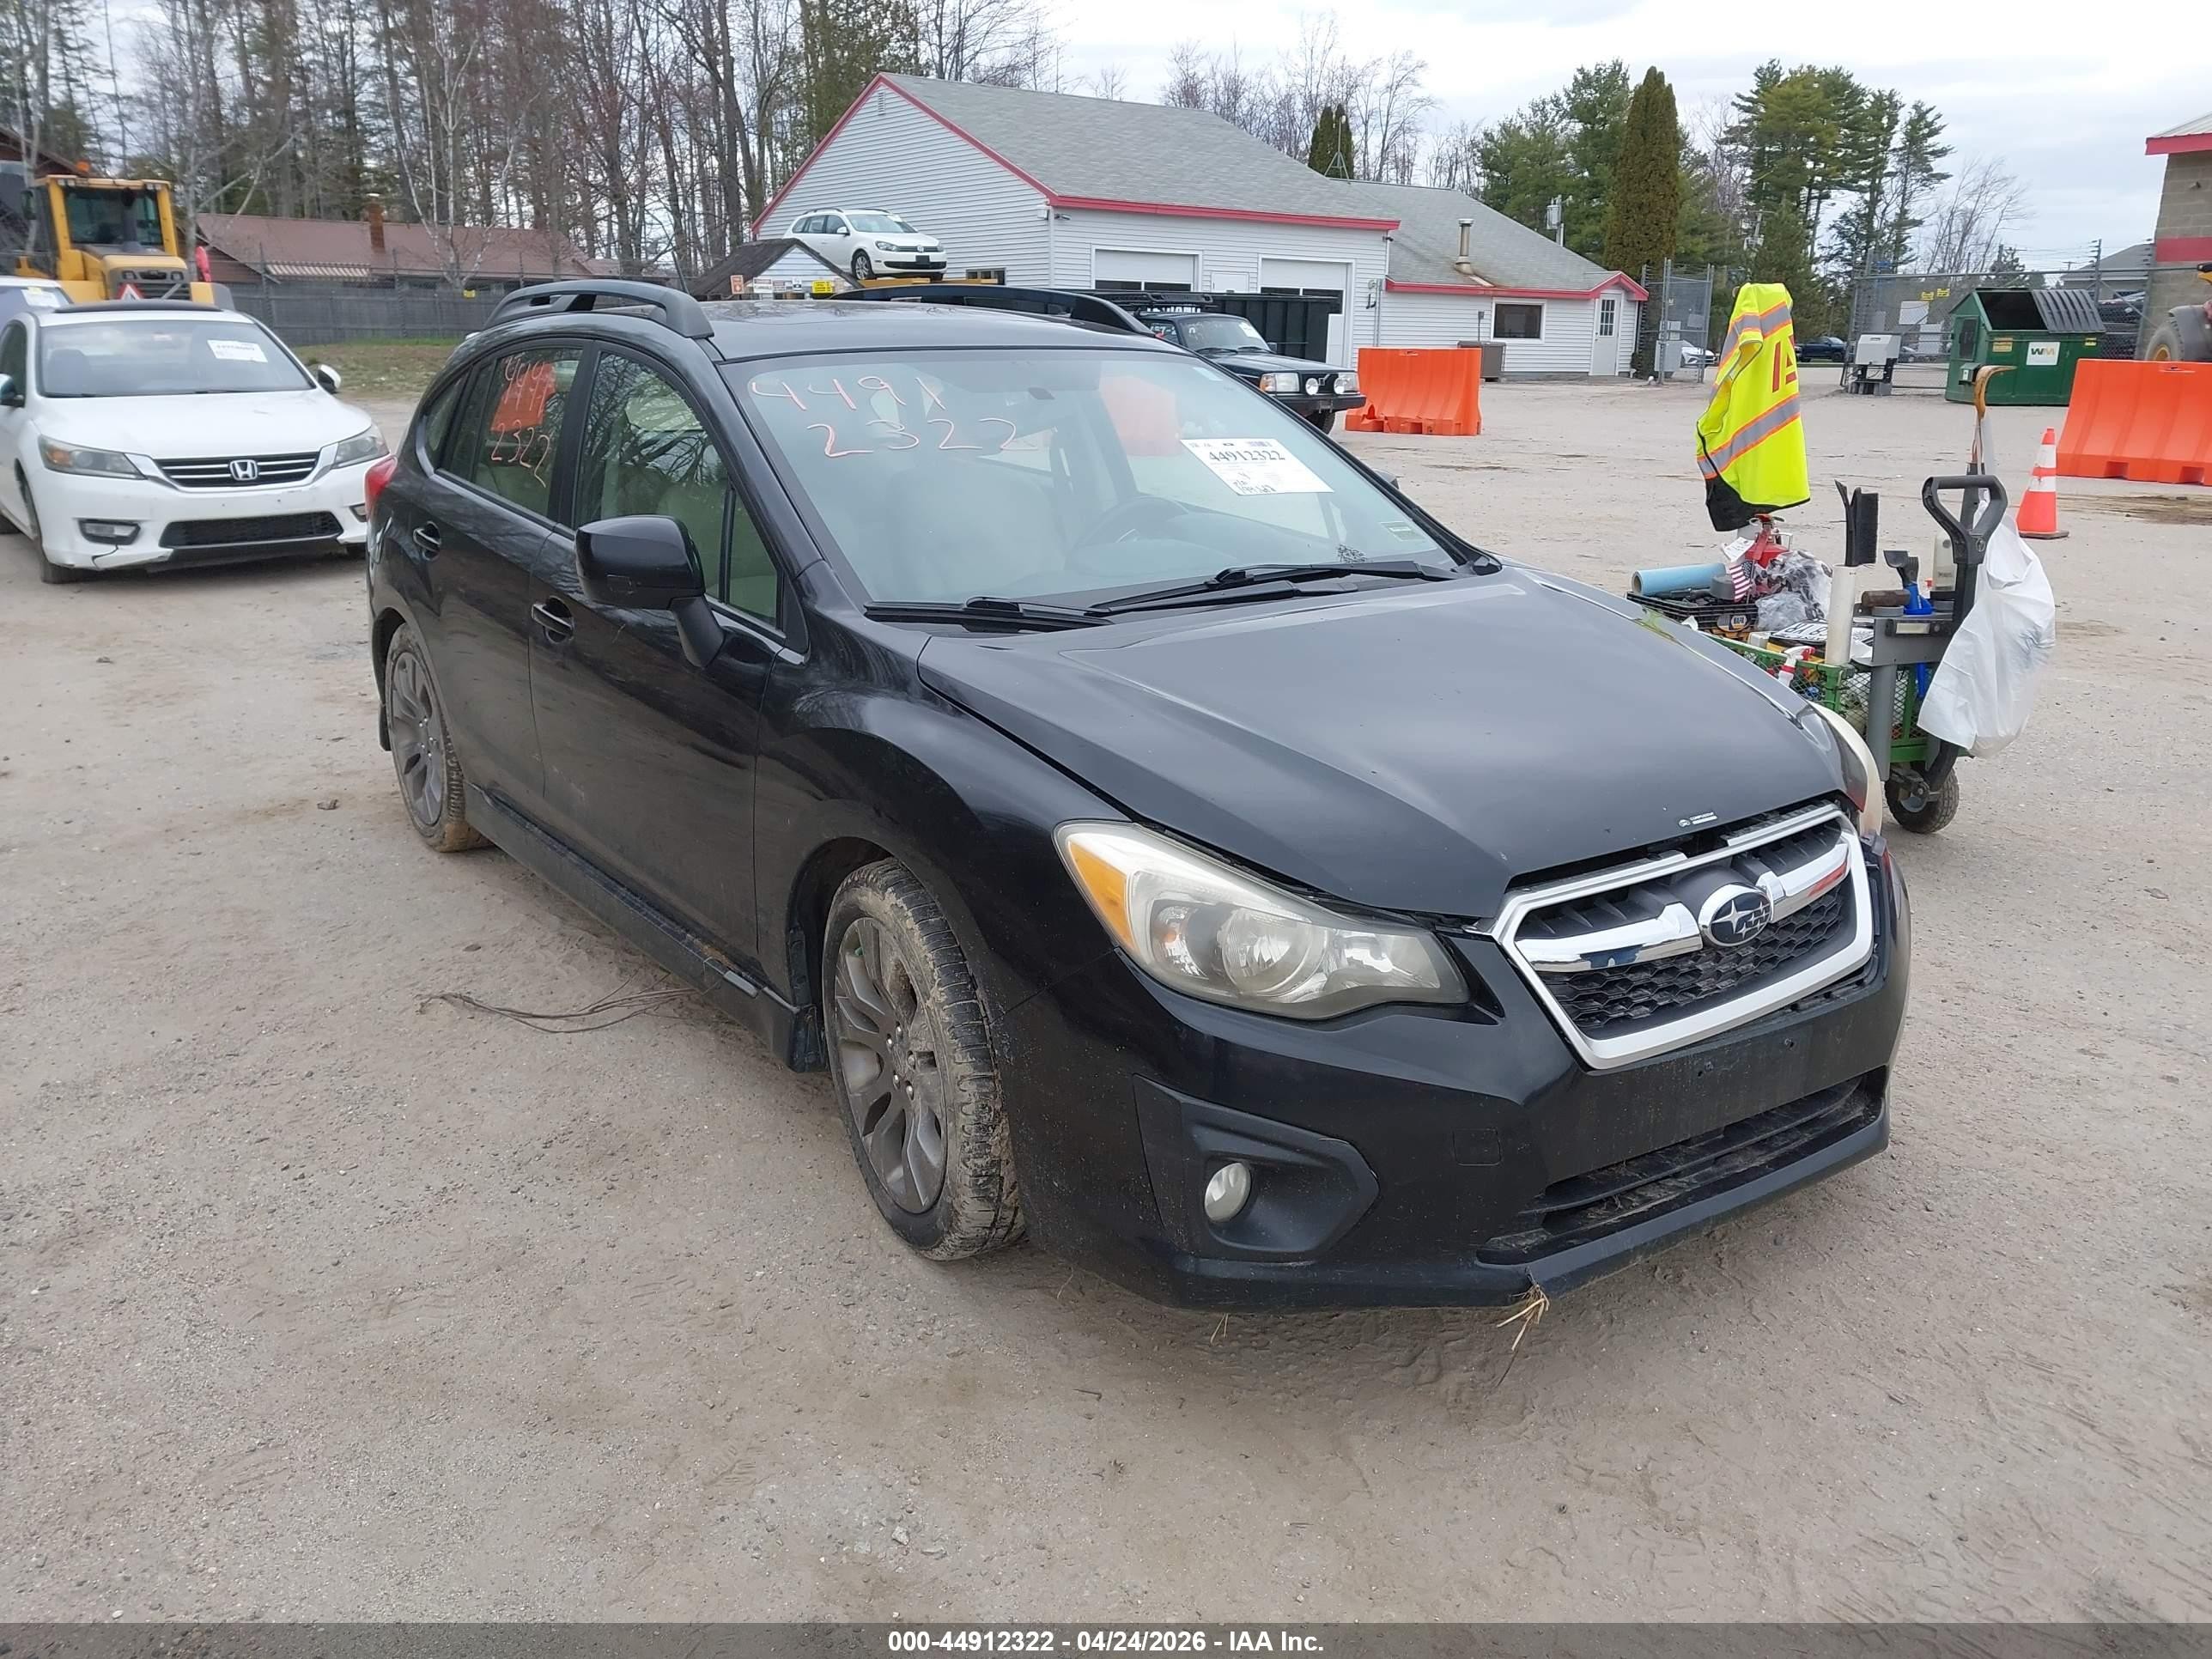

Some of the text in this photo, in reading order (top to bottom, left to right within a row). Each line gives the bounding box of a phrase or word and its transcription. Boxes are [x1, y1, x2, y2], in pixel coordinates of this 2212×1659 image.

[2031, 347, 2055, 356] WM
[752, 376, 946, 410] 4491
[490, 419, 550, 488] 2322
[806, 417, 1039, 457] 2322
[1209, 450, 1285, 461] 44912322
